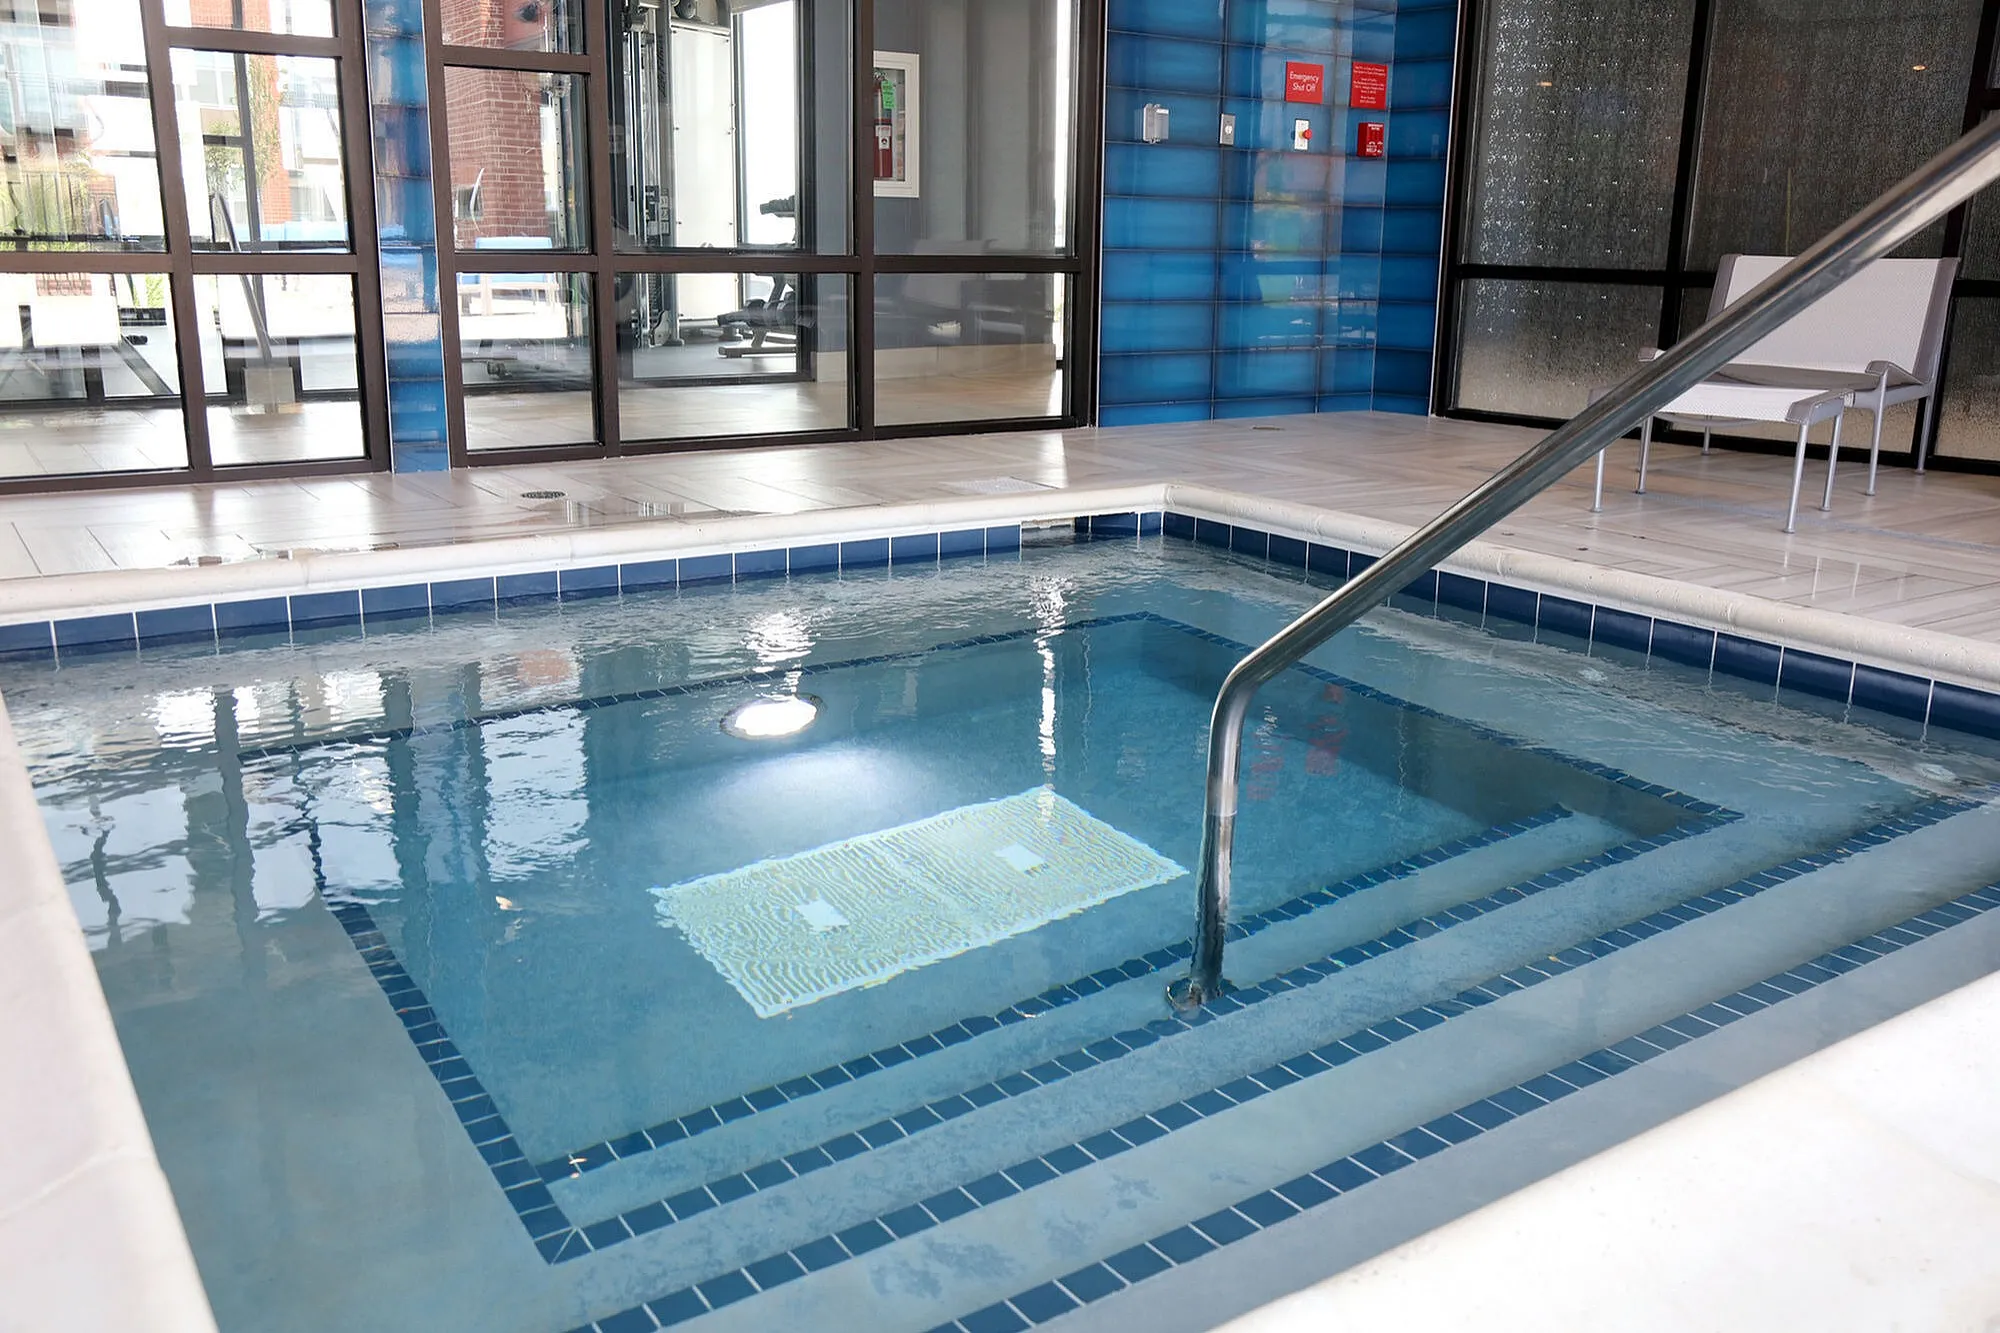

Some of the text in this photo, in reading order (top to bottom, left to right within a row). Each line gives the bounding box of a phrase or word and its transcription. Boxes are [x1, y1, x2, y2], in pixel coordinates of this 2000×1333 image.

[1290, 71, 1319, 84] Emergency
[1293, 82, 1316, 92] Shut Off
